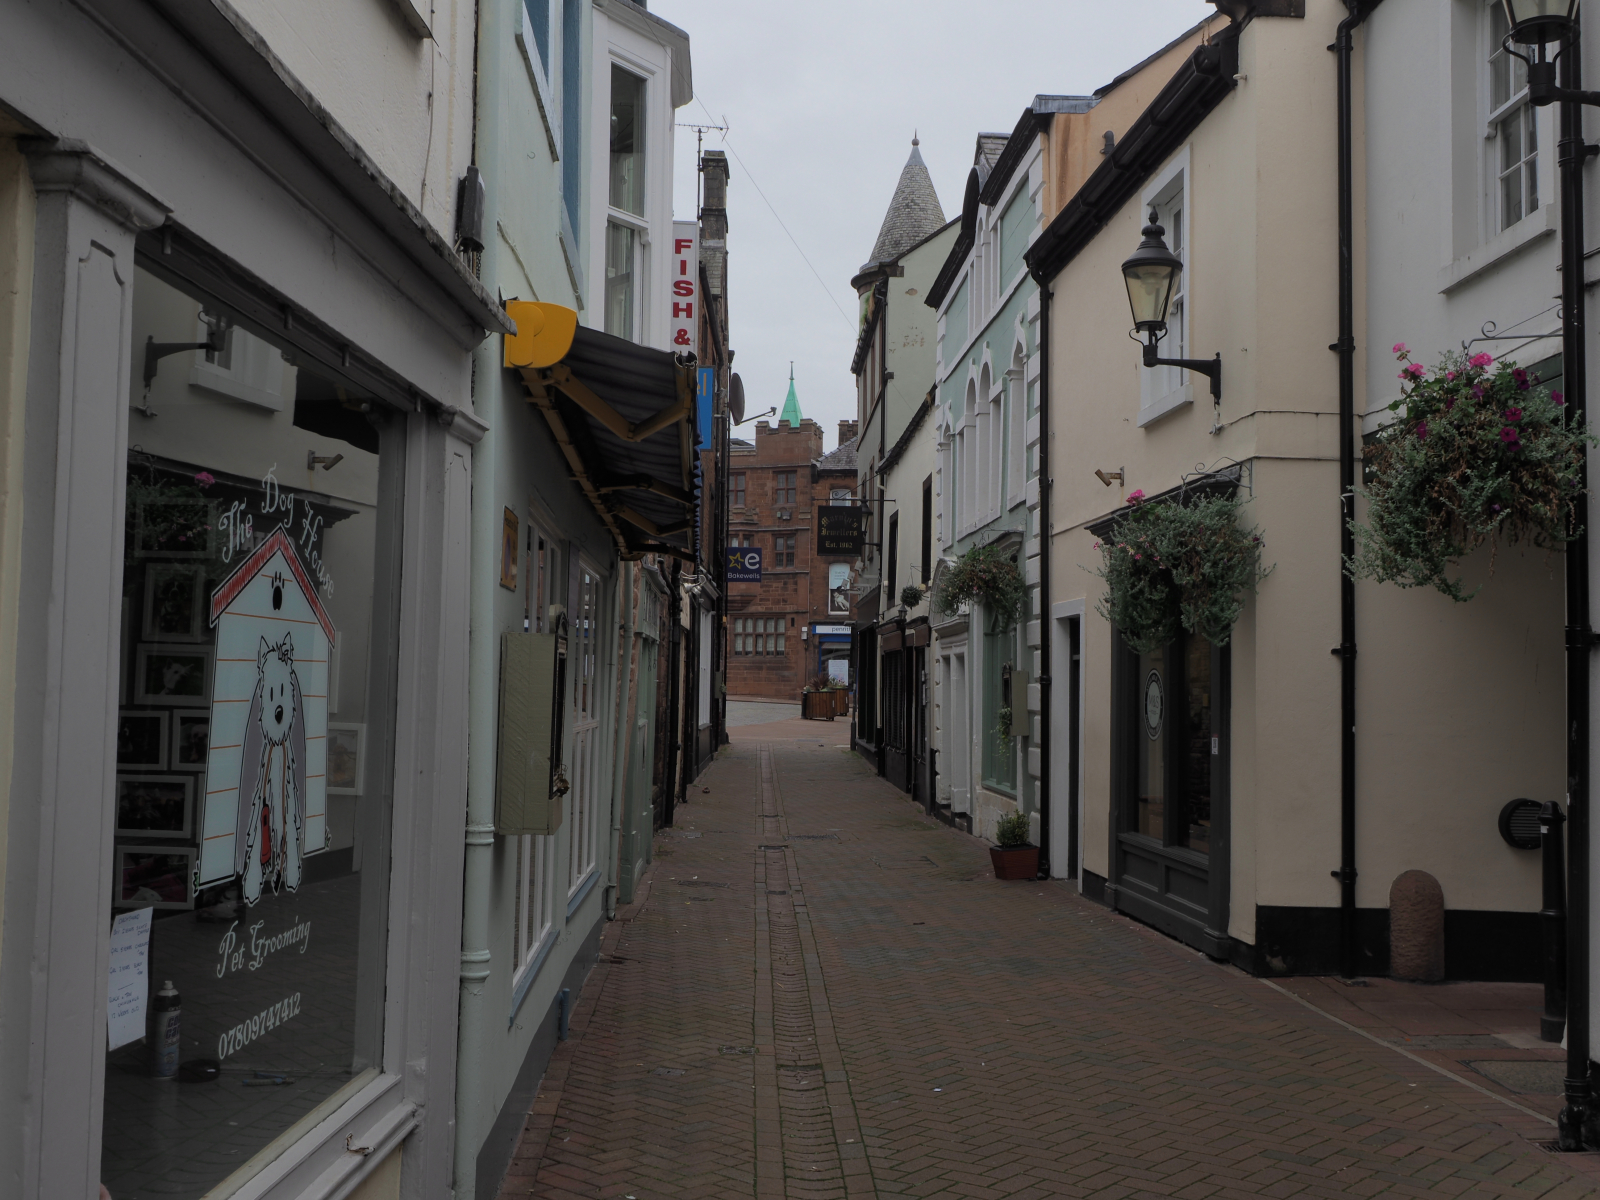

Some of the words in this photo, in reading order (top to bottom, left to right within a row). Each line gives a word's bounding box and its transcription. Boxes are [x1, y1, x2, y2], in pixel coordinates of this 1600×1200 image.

[673, 239, 694, 318] FISH
[674, 329, 690, 345] &
[218, 497, 253, 563] The
[261, 462, 294, 528] Dog
[300, 500, 334, 599] House
[821, 528, 858, 536] Jewellers
[217, 920, 245, 978] Pet
[248, 915, 311, 971] Grooming
[218, 992, 301, 1060] 07809747412
